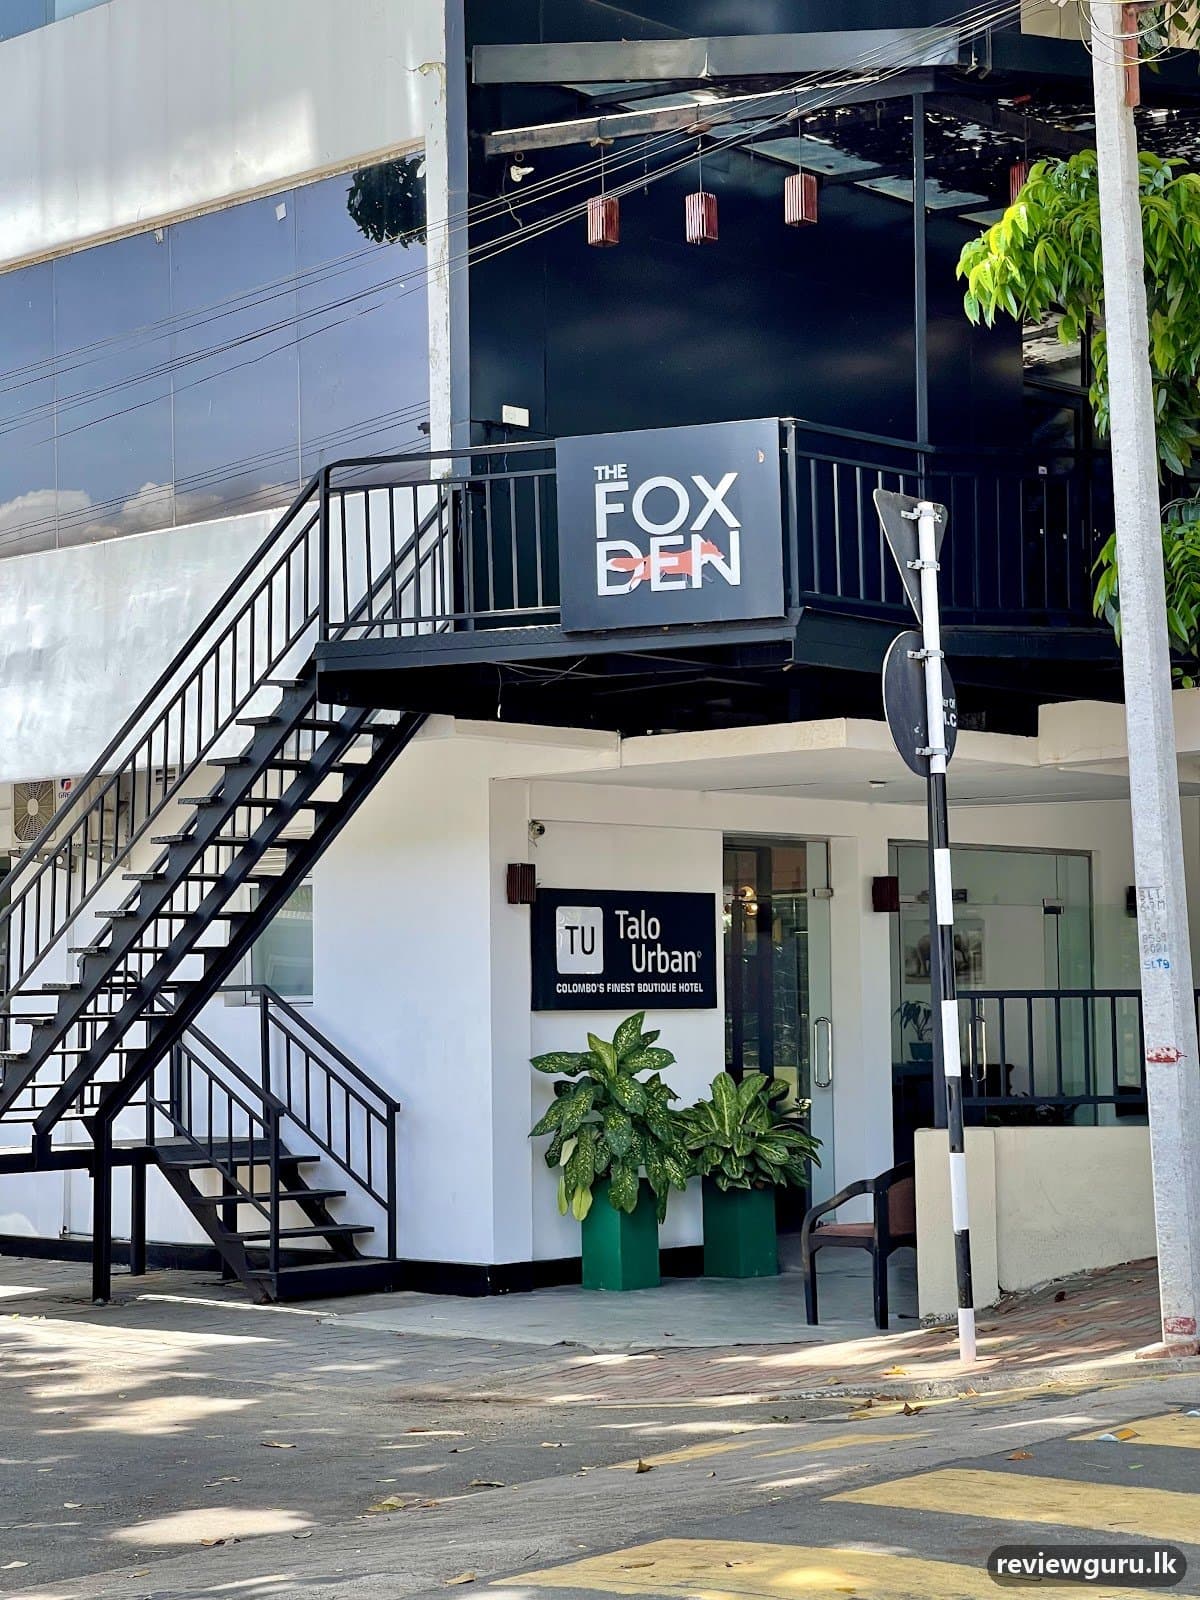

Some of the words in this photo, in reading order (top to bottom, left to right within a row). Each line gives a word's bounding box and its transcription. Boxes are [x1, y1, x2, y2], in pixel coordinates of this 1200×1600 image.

[594, 464, 627, 480] THE
[595, 473, 741, 538] FOX
[596, 531, 740, 596] DEN
[615, 910, 660, 939] Talo
[565, 926, 595, 955] TU
[556, 983, 605, 994] COLOMBO'S
[607, 983, 635, 993] FINEST
[637, 983, 677, 993] BOUTIQUE
[679, 983, 703, 993] HOTEL
